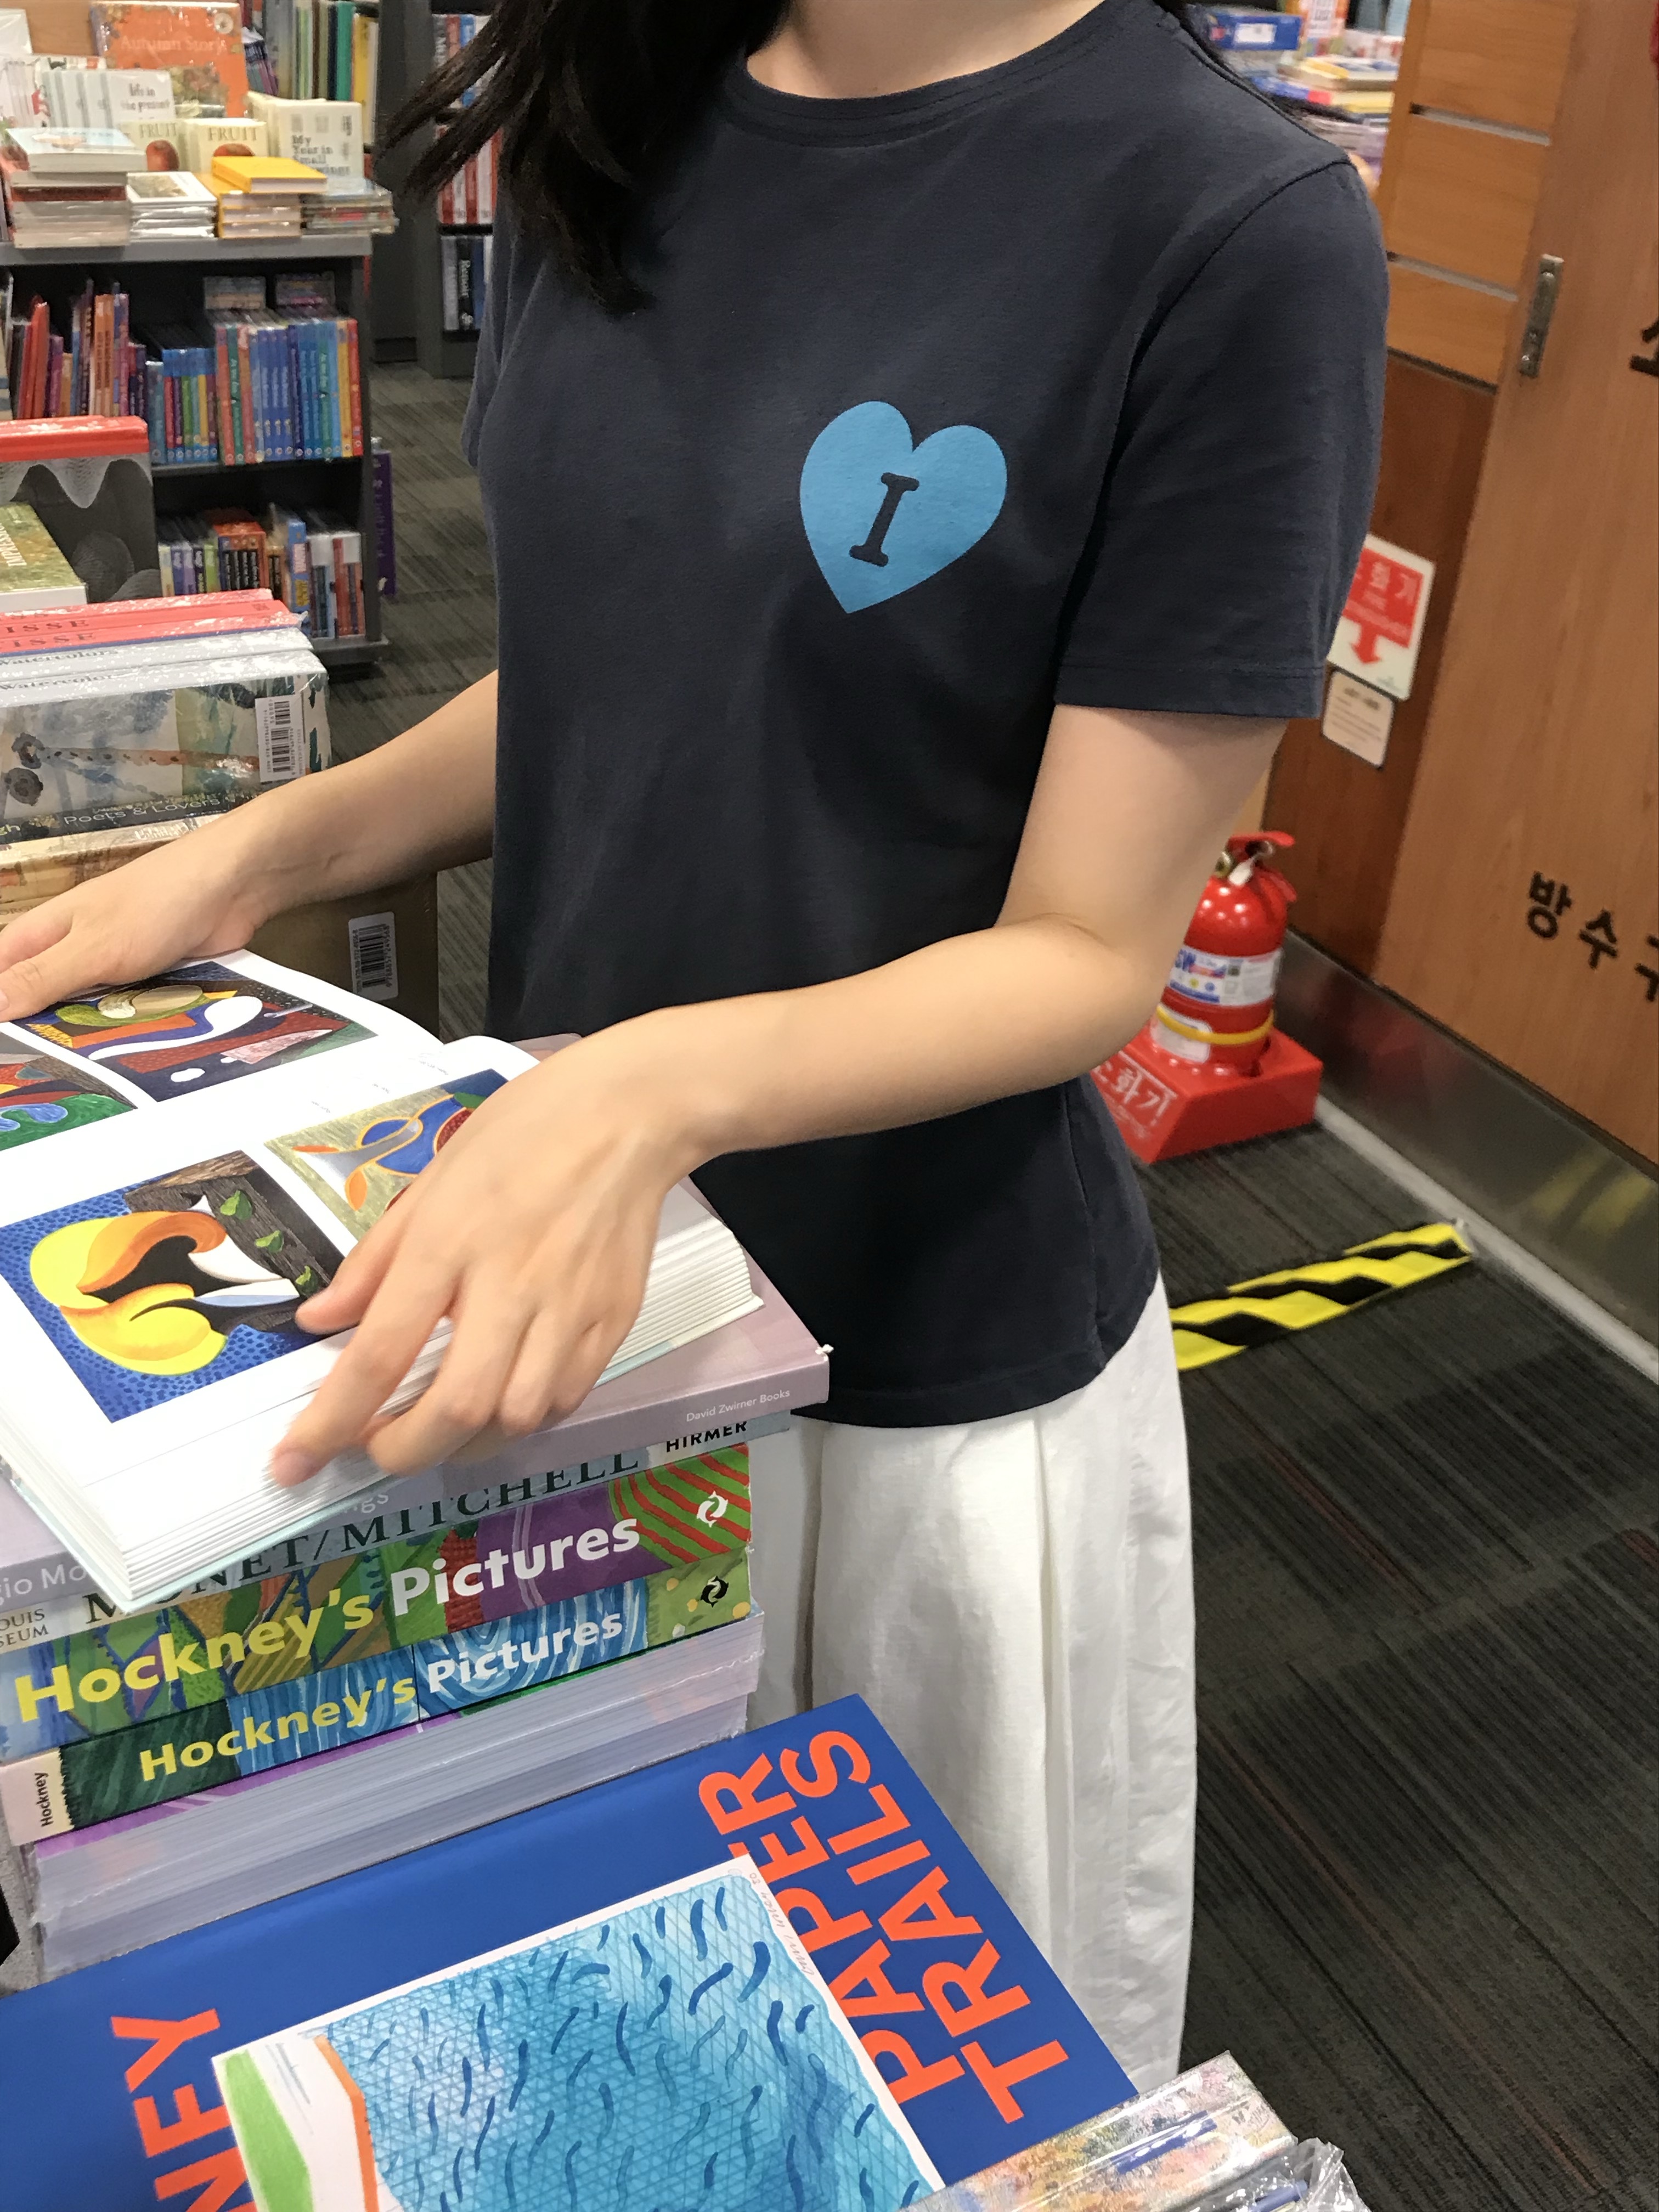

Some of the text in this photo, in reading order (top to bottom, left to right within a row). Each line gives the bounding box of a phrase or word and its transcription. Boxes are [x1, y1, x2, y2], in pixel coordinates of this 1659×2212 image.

[139, 122, 177, 137] FRUIT
[208, 127, 257, 140] FRUIT
[850, 472, 919, 567] I
[0, 675, 115, 690] Watercolor
[63, 811, 126, 825] Poets
[133, 807, 146, 815] &
[151, 798, 221, 813] Lovers
[686, 1390, 791, 1422] David Zwirner Books
[666, 1421, 748, 1453] HIRMER
[82, 1453, 639, 1625] MET/MITCHELL
[14, 1517, 640, 1723] Hockney's Pictures
[139, 1612, 623, 1780] Hockney's Pictures
[35, 1772, 54, 1827] Hockney
[698, 1753, 965, 2103] PAPER
[780, 1730, 1069, 2124] TRAILS
